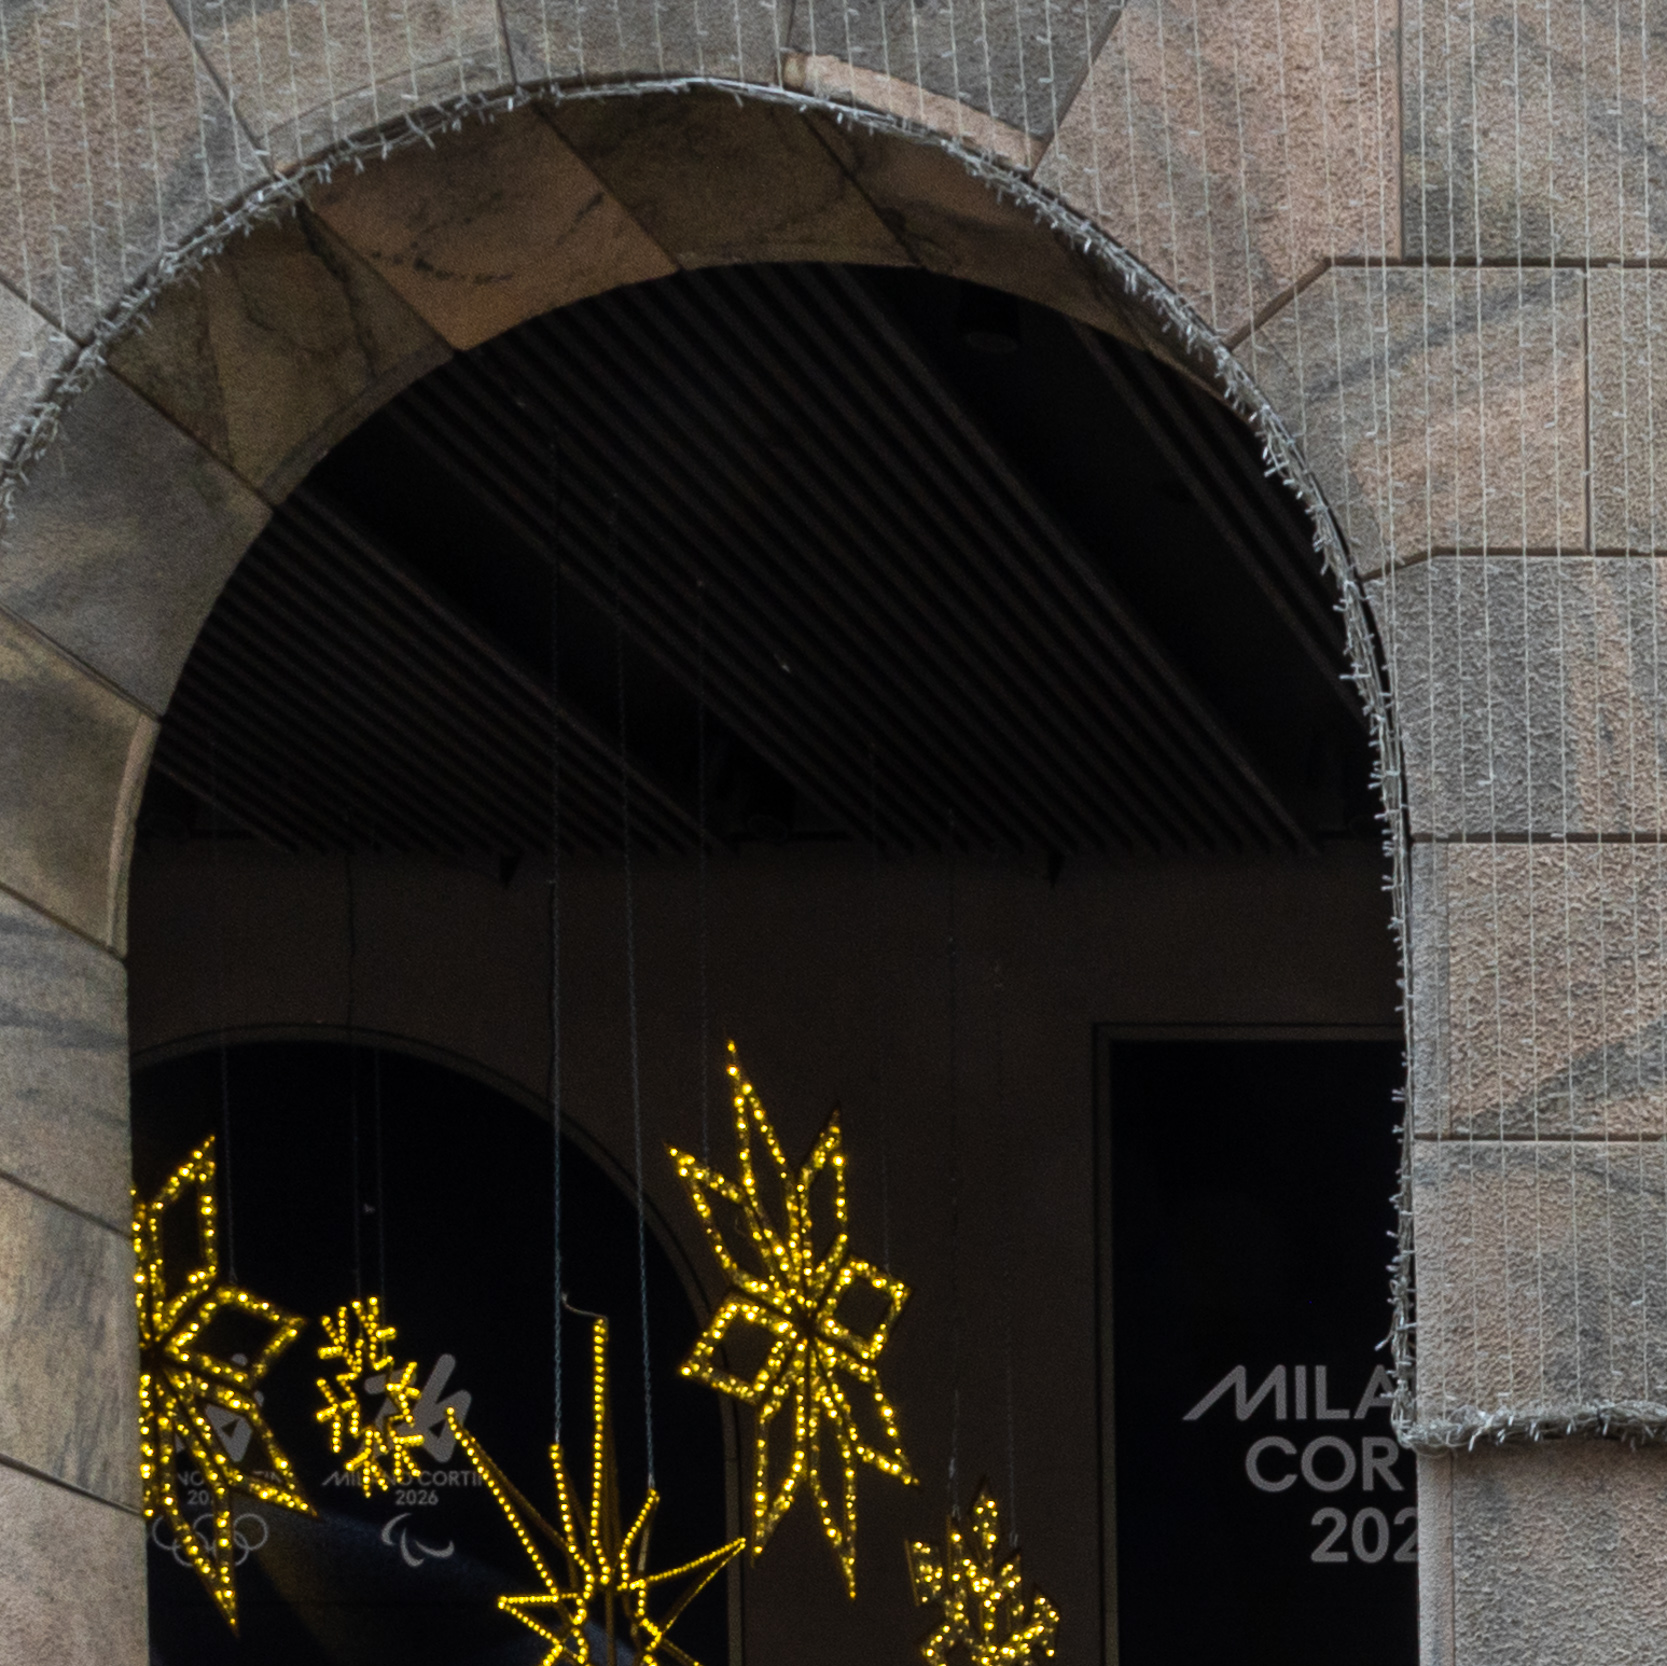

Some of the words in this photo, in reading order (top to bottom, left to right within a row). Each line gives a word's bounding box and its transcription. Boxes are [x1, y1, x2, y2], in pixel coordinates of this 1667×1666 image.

[1182, 1364, 1396, 1421] MILA
[418, 1471, 483, 1487] CORTI
[395, 1490, 440, 1506] 2026
[1310, 1507, 1419, 1563] 202
